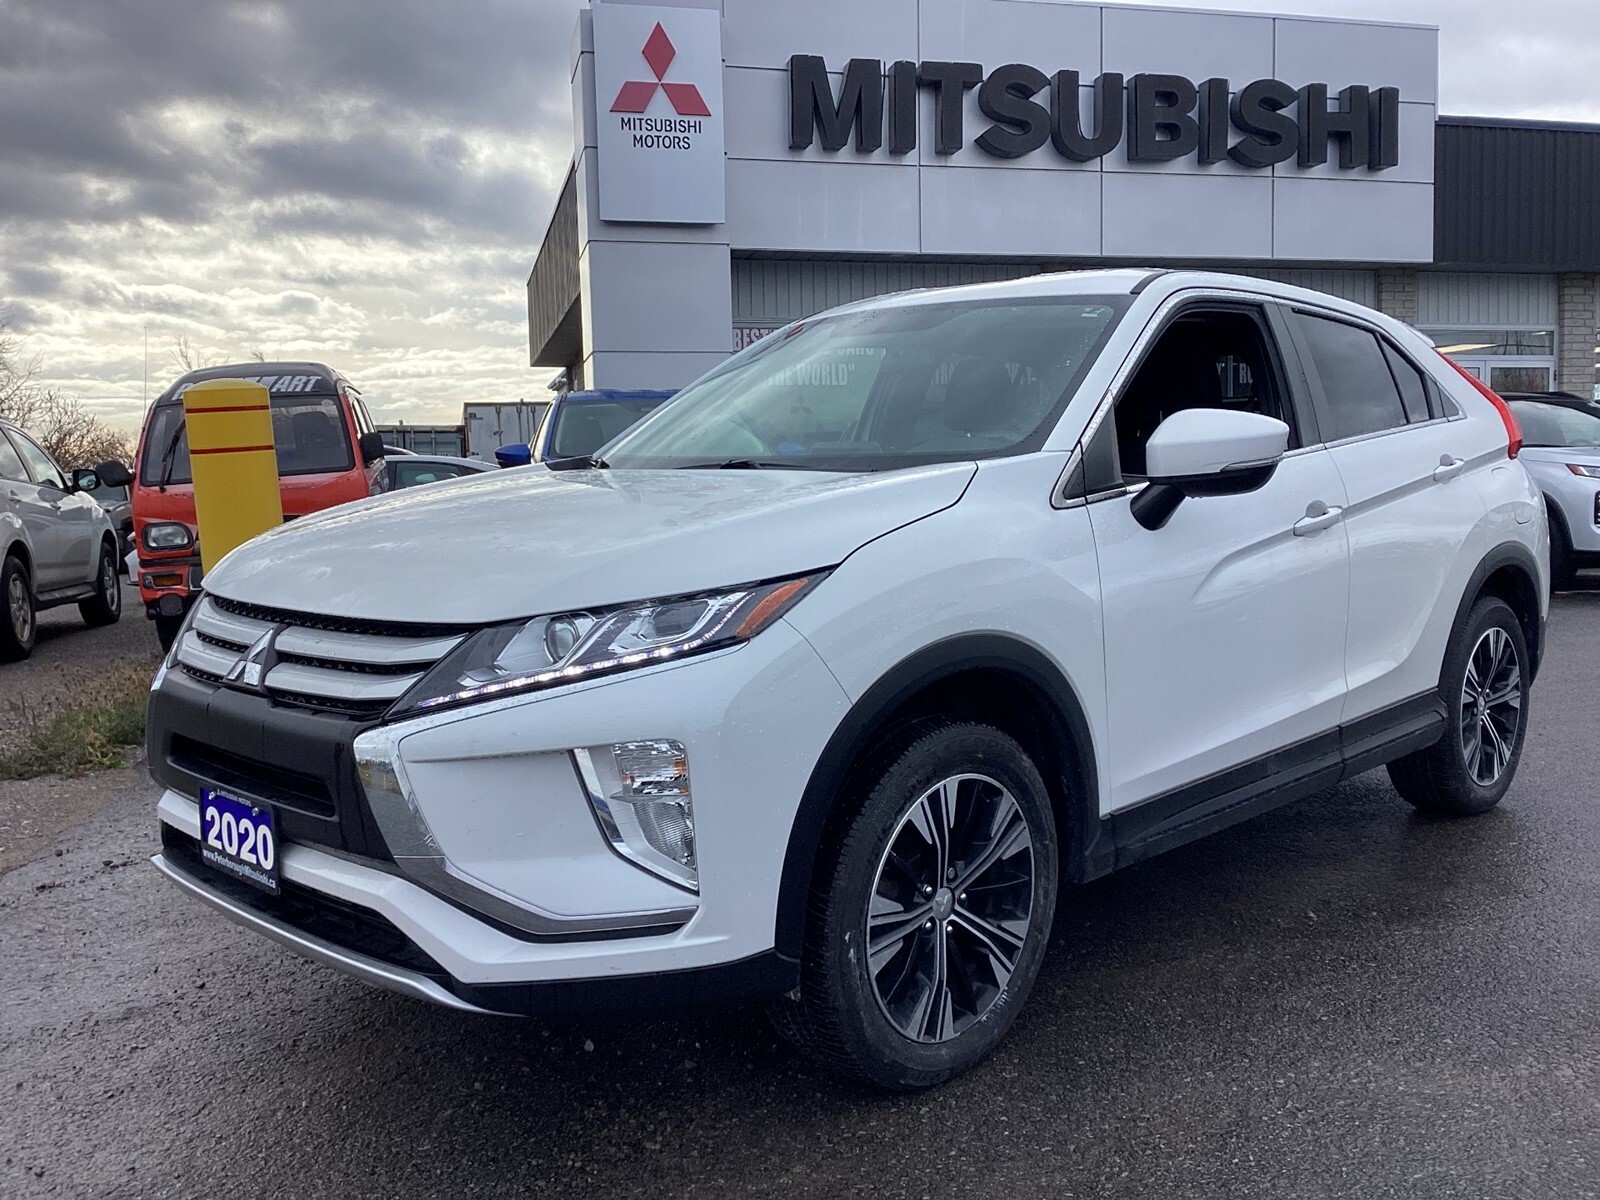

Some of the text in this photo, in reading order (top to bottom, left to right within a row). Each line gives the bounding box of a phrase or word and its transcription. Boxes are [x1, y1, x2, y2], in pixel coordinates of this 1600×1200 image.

[620, 117, 702, 134] MITSUBISHI
[787, 54, 1400, 172] MITSUBISHI
[633, 134, 691, 150] MOTORS
[205, 806, 274, 870] 2020
